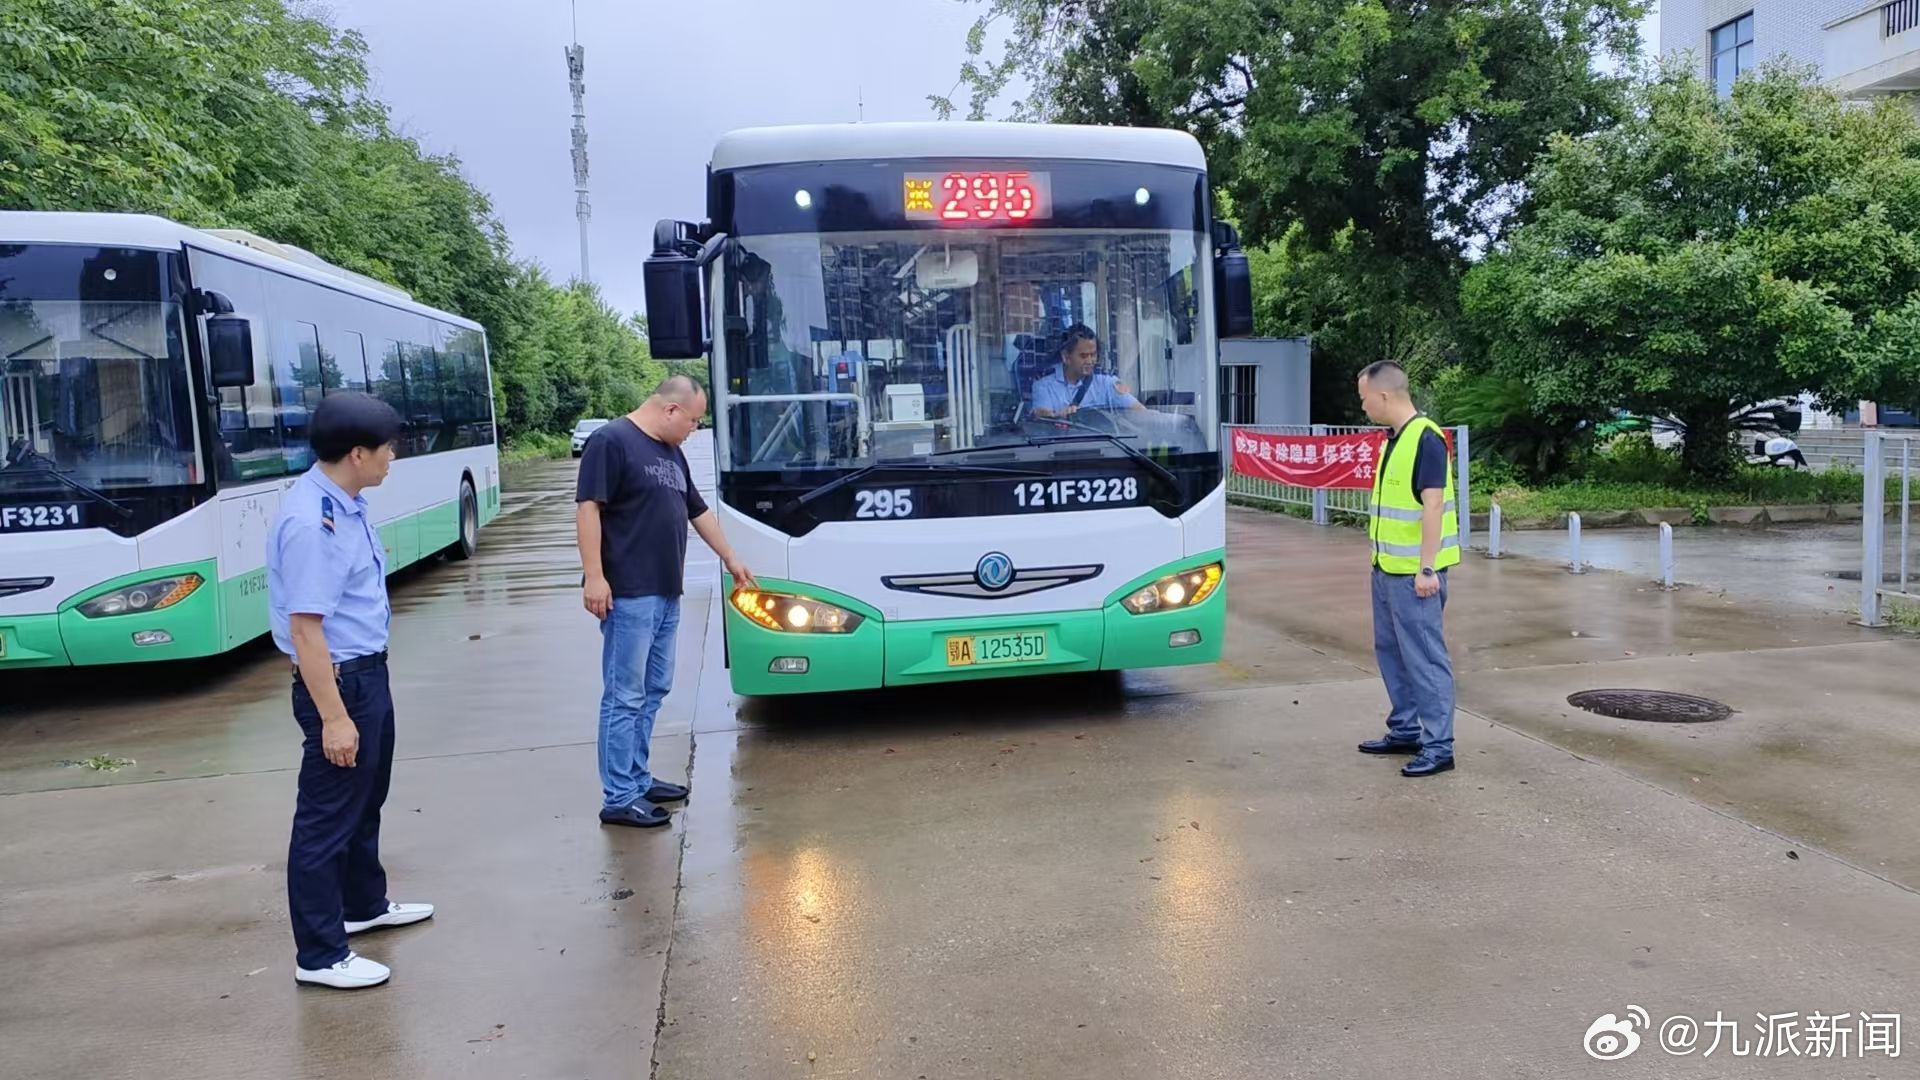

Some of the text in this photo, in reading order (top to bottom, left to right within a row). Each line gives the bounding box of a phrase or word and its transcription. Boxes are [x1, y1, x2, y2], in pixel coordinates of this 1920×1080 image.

[942, 173, 1032, 219] 295
[1323, 442, 1373, 464] 保安全
[855, 488, 913, 518] 295
[1013, 477, 1138, 507] 121F3228
[0, 504, 79, 528] F3231
